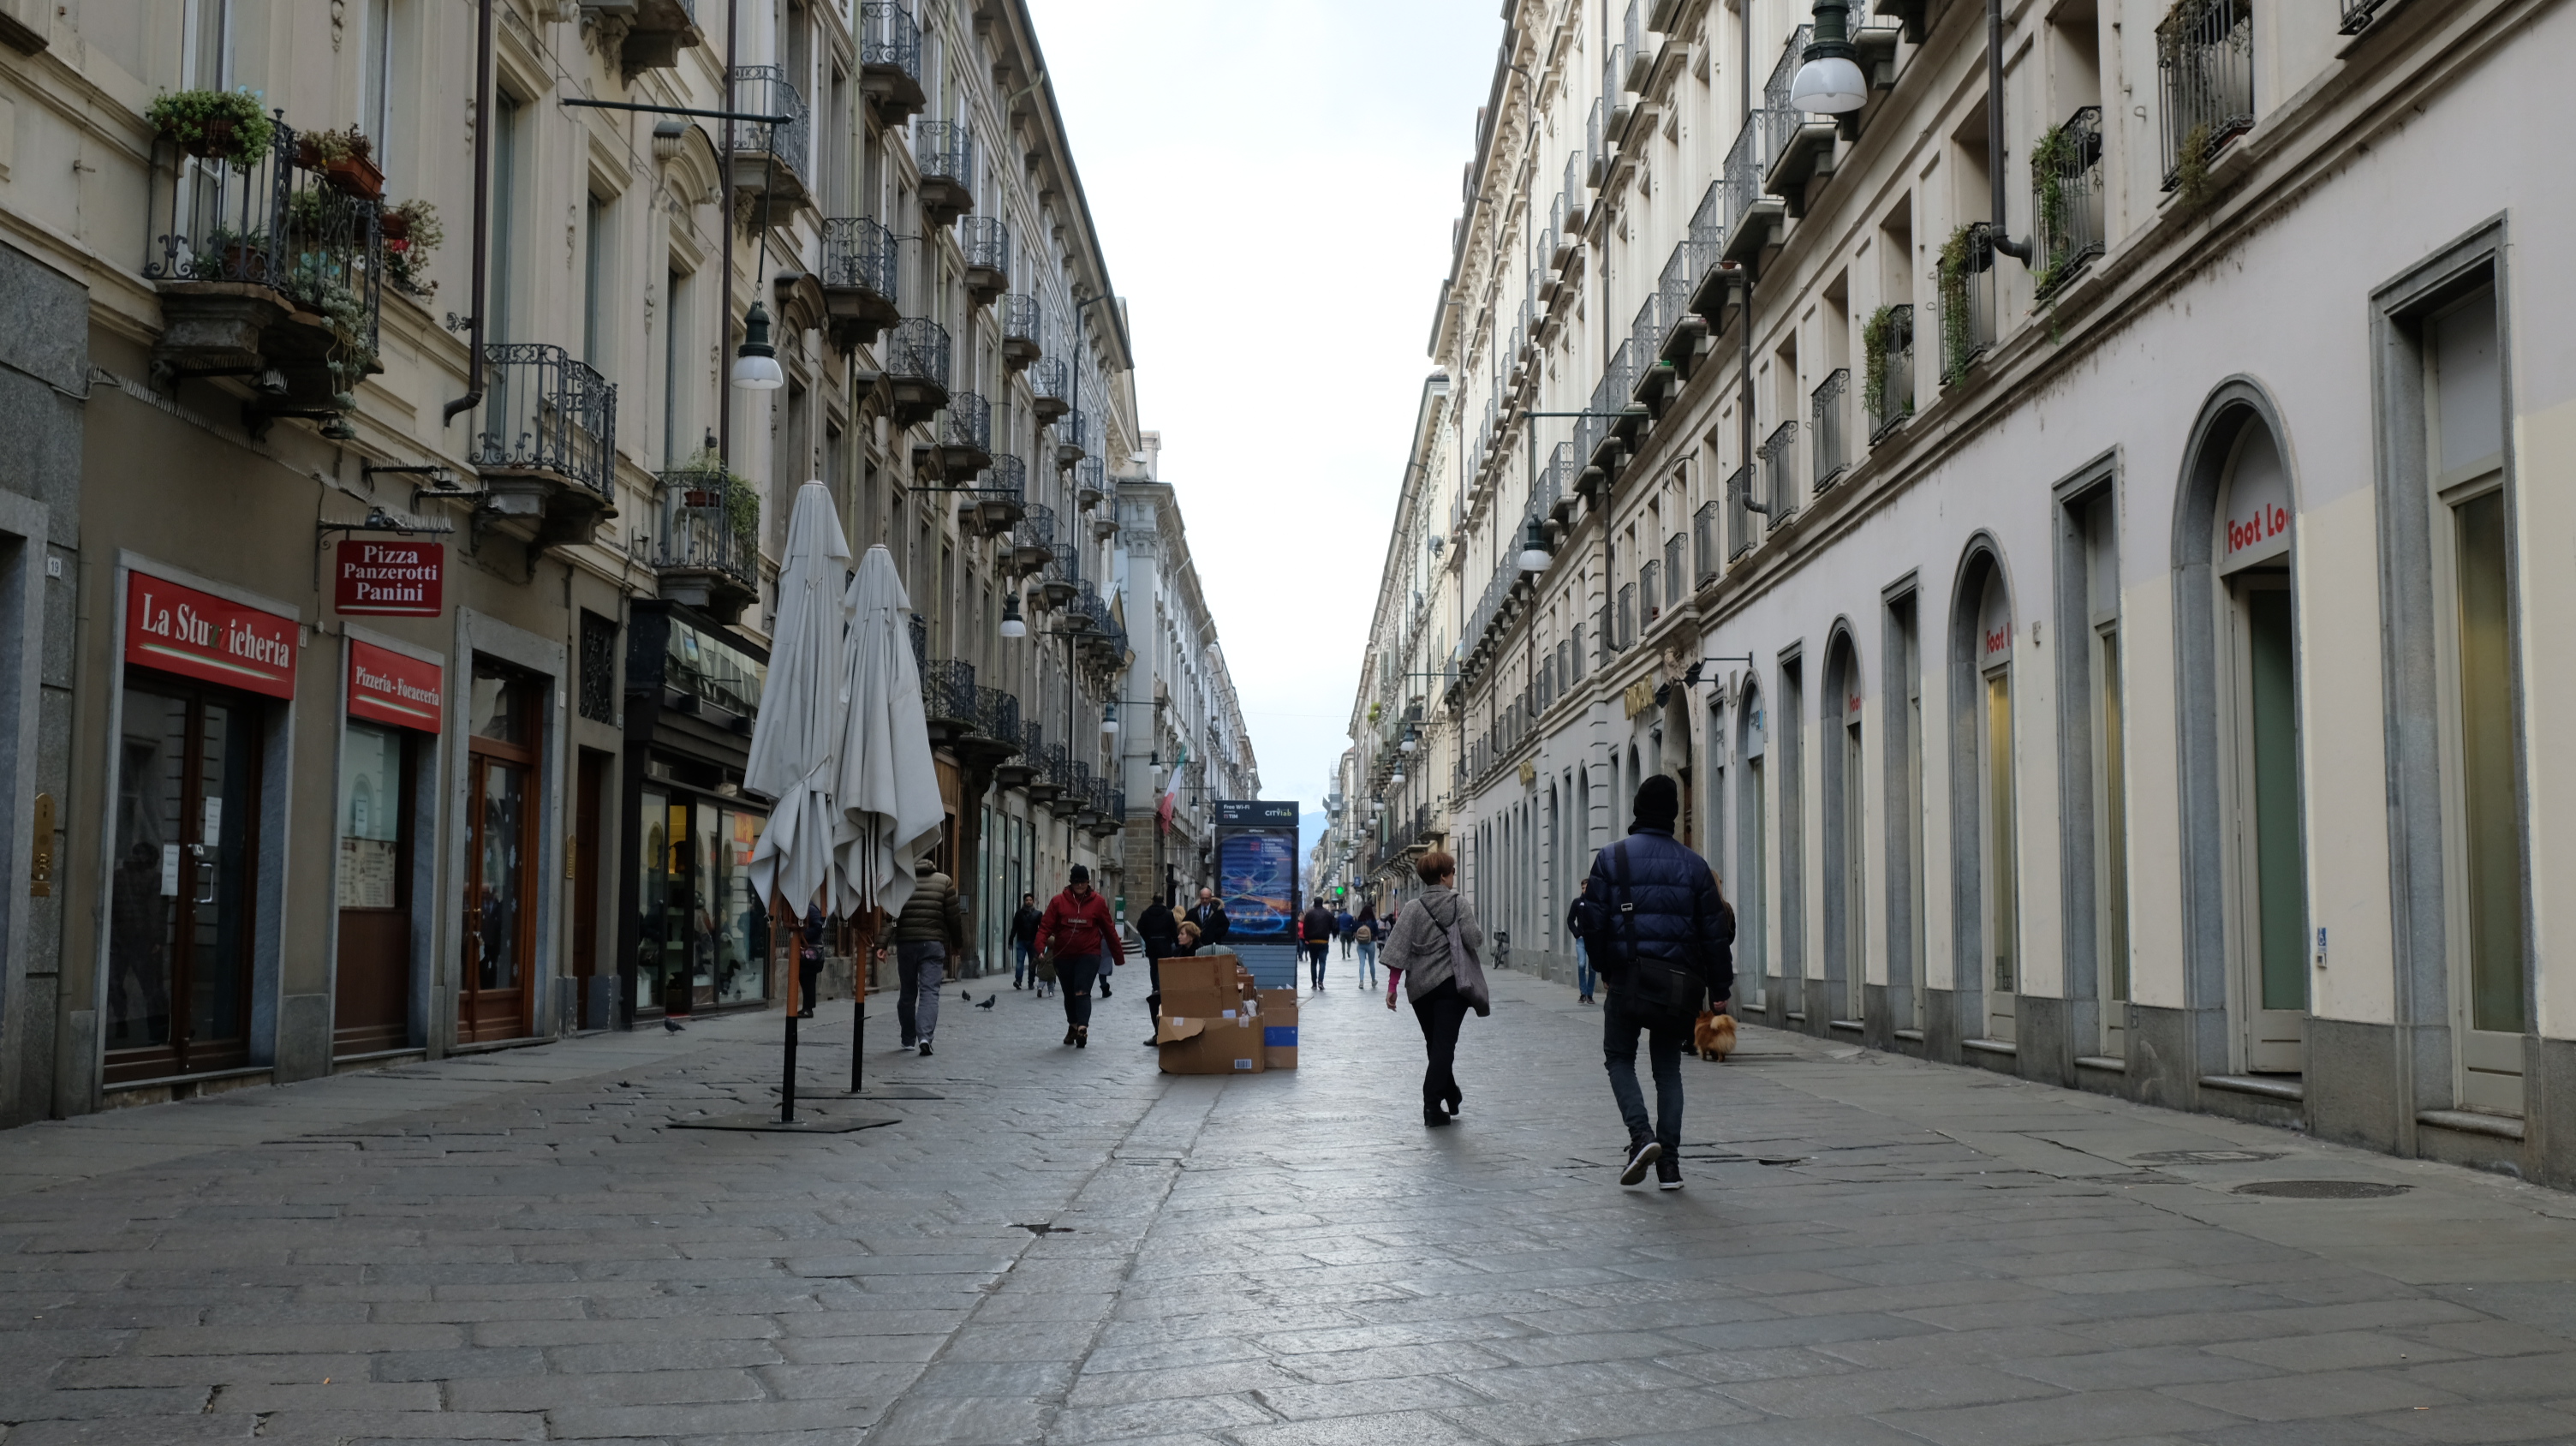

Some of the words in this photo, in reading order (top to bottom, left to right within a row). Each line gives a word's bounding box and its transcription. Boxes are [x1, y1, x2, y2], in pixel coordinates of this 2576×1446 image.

[2228, 519, 2262, 554] Foot
[362, 544, 418, 565] Pizza
[51, 560, 59, 573] 19
[343, 562, 437, 580] Panzerotti
[356, 582, 423, 601] Panini
[141, 593, 170, 636] La
[176, 603, 290, 668] Stuzzicheria
[355, 666, 391, 693] Pizzeria
[397, 678, 439, 707] Focacceria
